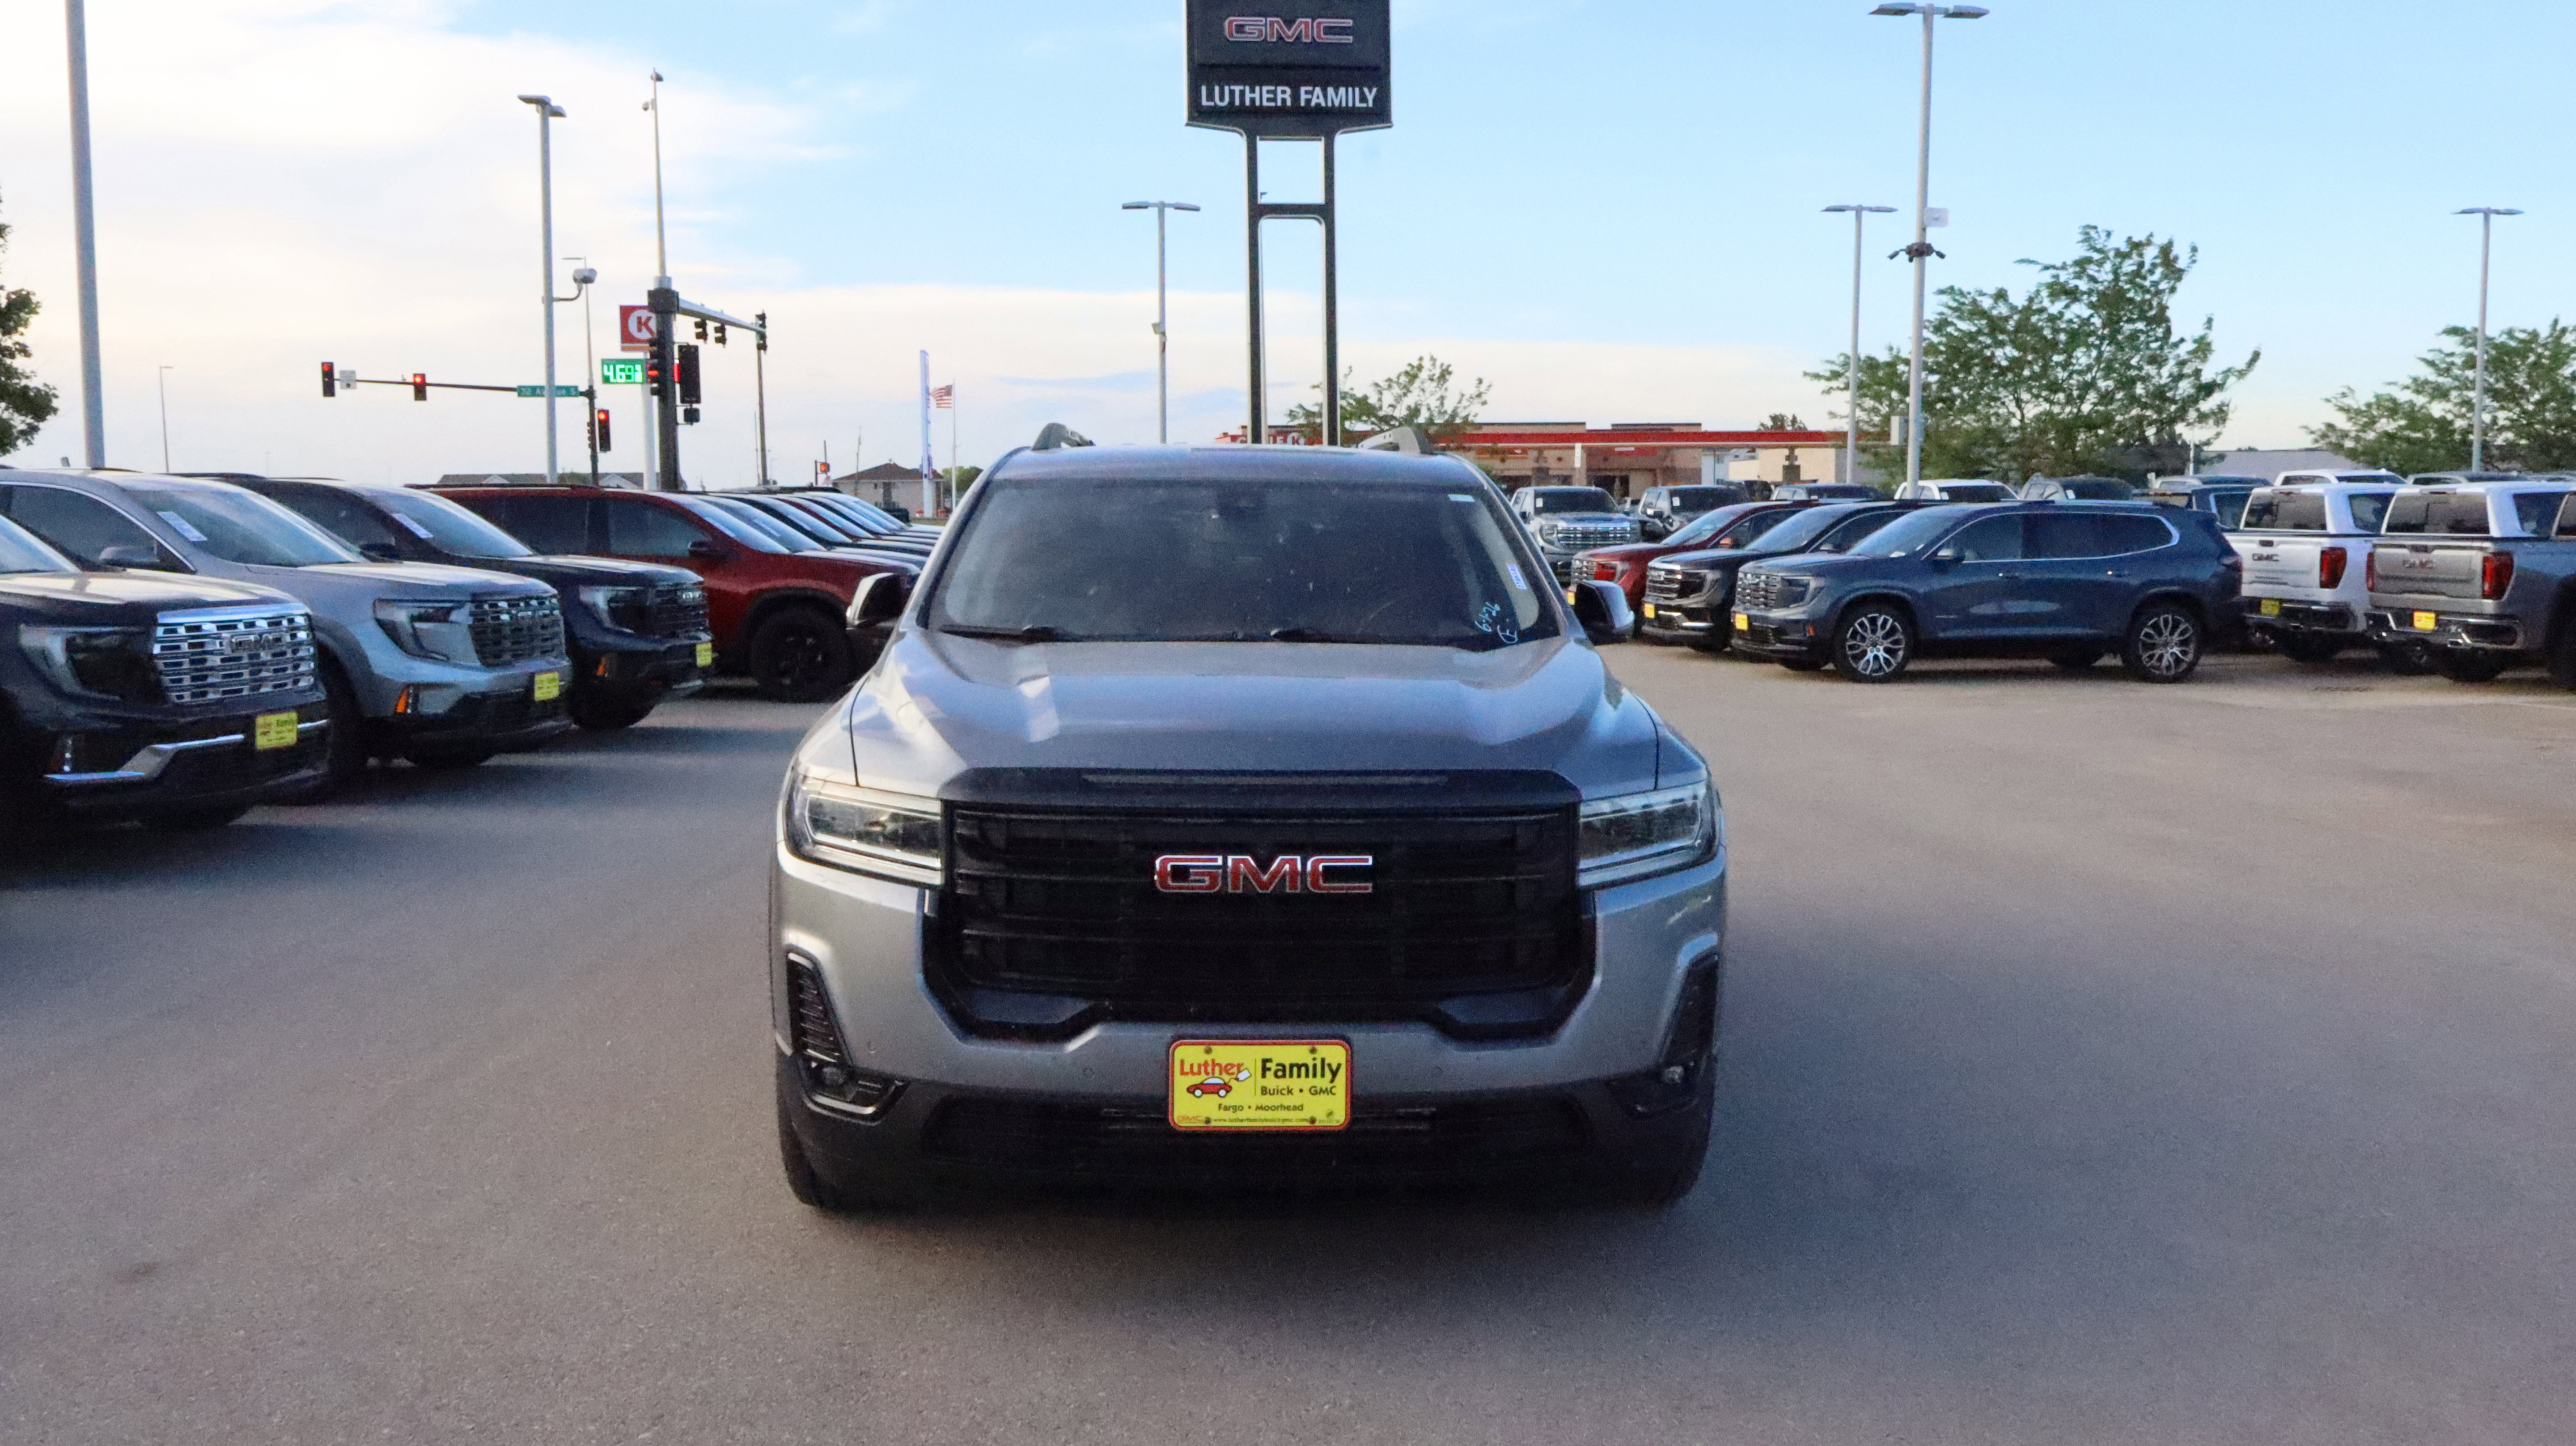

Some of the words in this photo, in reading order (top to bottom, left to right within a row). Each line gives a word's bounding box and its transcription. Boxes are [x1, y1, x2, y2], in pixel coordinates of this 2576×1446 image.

[1224, 17, 1353, 43] GMC
[1201, 85, 1291, 107] LUTHER
[1300, 86, 1377, 107] FAMILY
[636, 316, 655, 337] K
[2251, 553, 2279, 562] GMC
[1155, 855, 1373, 893] GMC
[1179, 1058, 1244, 1076] Luther
[1260, 1057, 1342, 1083] Family
[1260, 1086, 1294, 1096] Buick
[1309, 1086, 1336, 1096] GMC
[1218, 1103, 1244, 1113] Fargo
[1255, 1103, 1304, 1111] Moorhead
